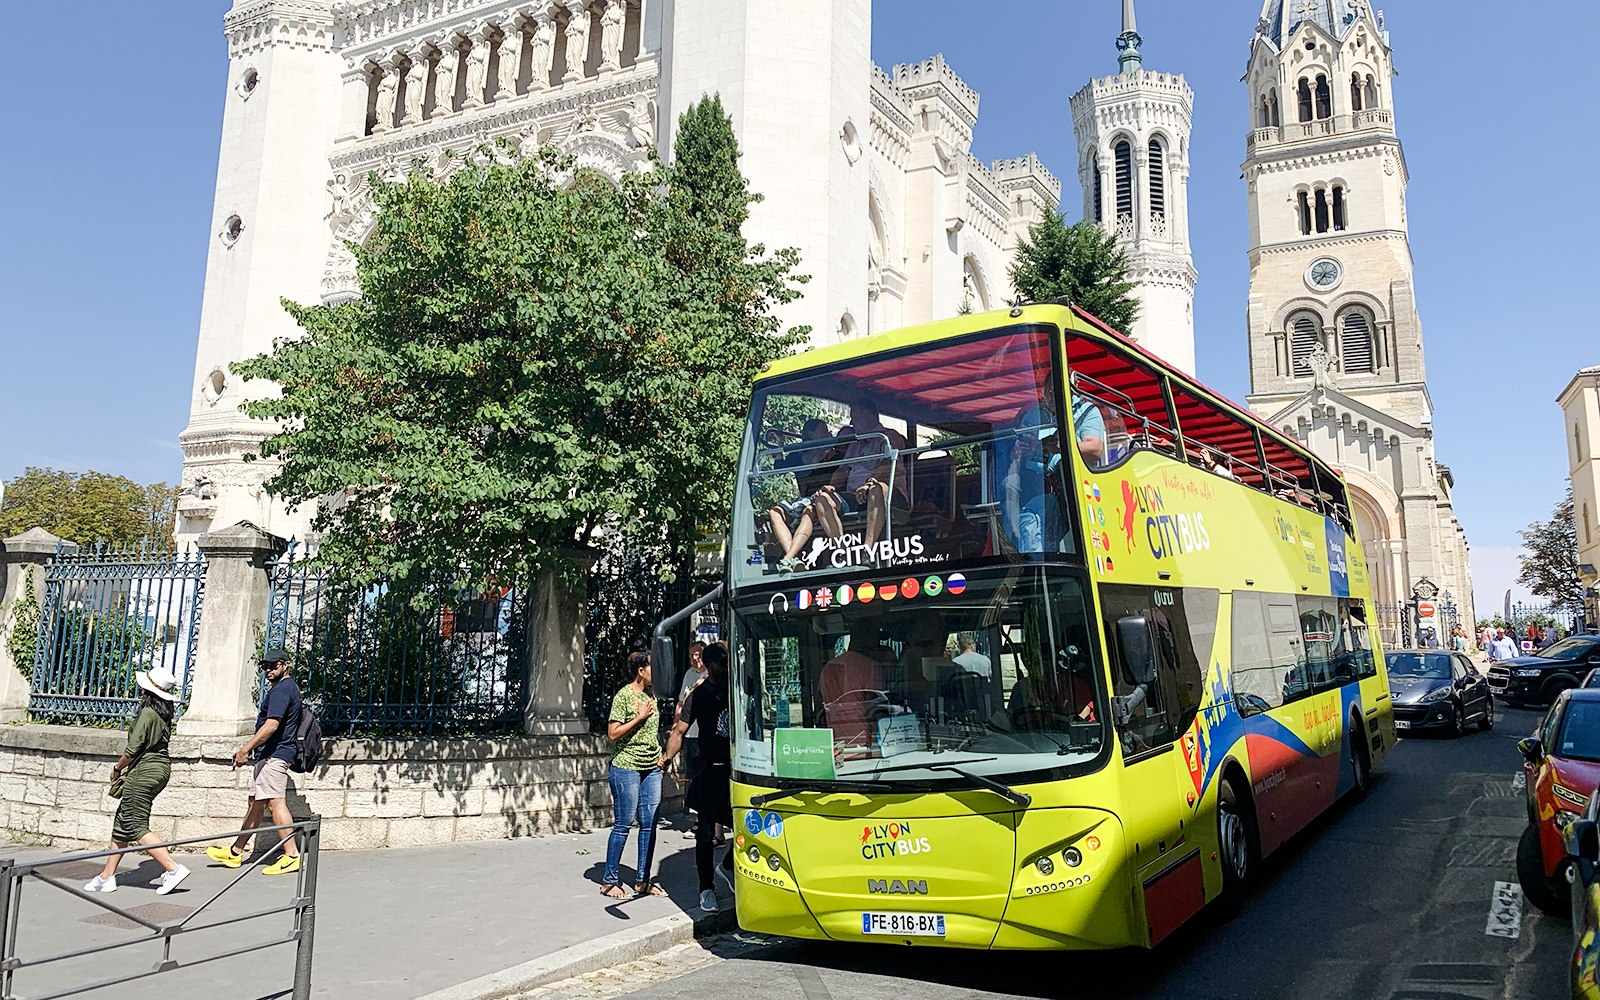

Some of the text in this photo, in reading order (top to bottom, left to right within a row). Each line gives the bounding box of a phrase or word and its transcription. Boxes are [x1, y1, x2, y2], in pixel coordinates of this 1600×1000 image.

[1134, 484, 1165, 513] LYON
[829, 532, 862, 550] LYON
[1146, 512, 1210, 560] CITYBUS
[831, 535, 925, 568] CITYBUS
[792, 746, 808, 755] Ligne
[873, 822, 911, 840] LYON
[861, 837, 931, 860] CITYBUS
[867, 879, 928, 895] MAN
[871, 914, 935, 931] FE-816-BX
